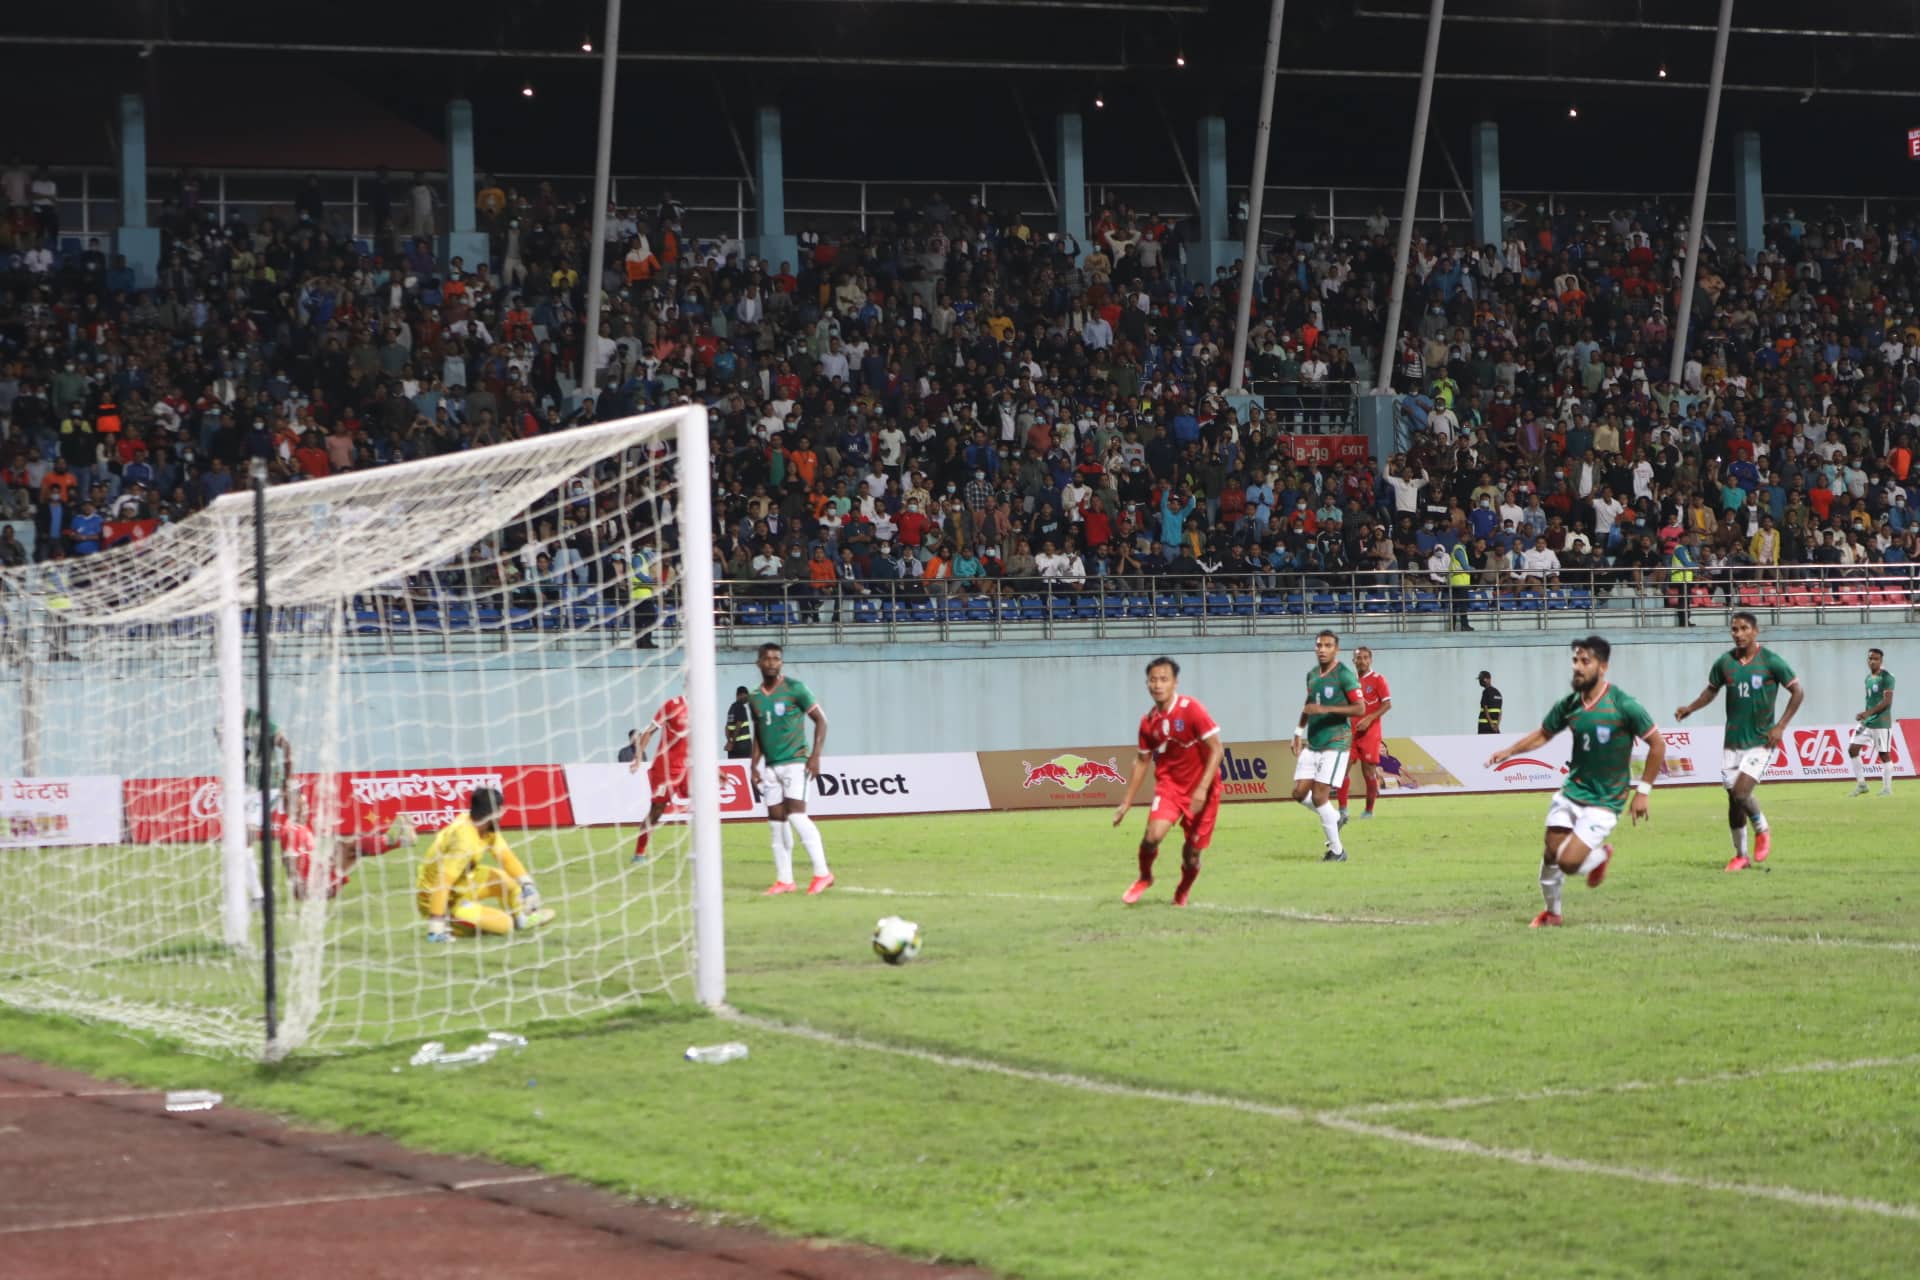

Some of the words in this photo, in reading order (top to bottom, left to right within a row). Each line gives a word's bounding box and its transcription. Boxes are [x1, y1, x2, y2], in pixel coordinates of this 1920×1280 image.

[1342, 445, 1364, 456] EXIT
[1737, 682, 1750, 698] 12
[1582, 733, 1591, 752] 2
[1802, 766, 1849, 776] DishHome
[816, 774, 909, 797] Direct
[1223, 782, 1268, 795] DRINK
